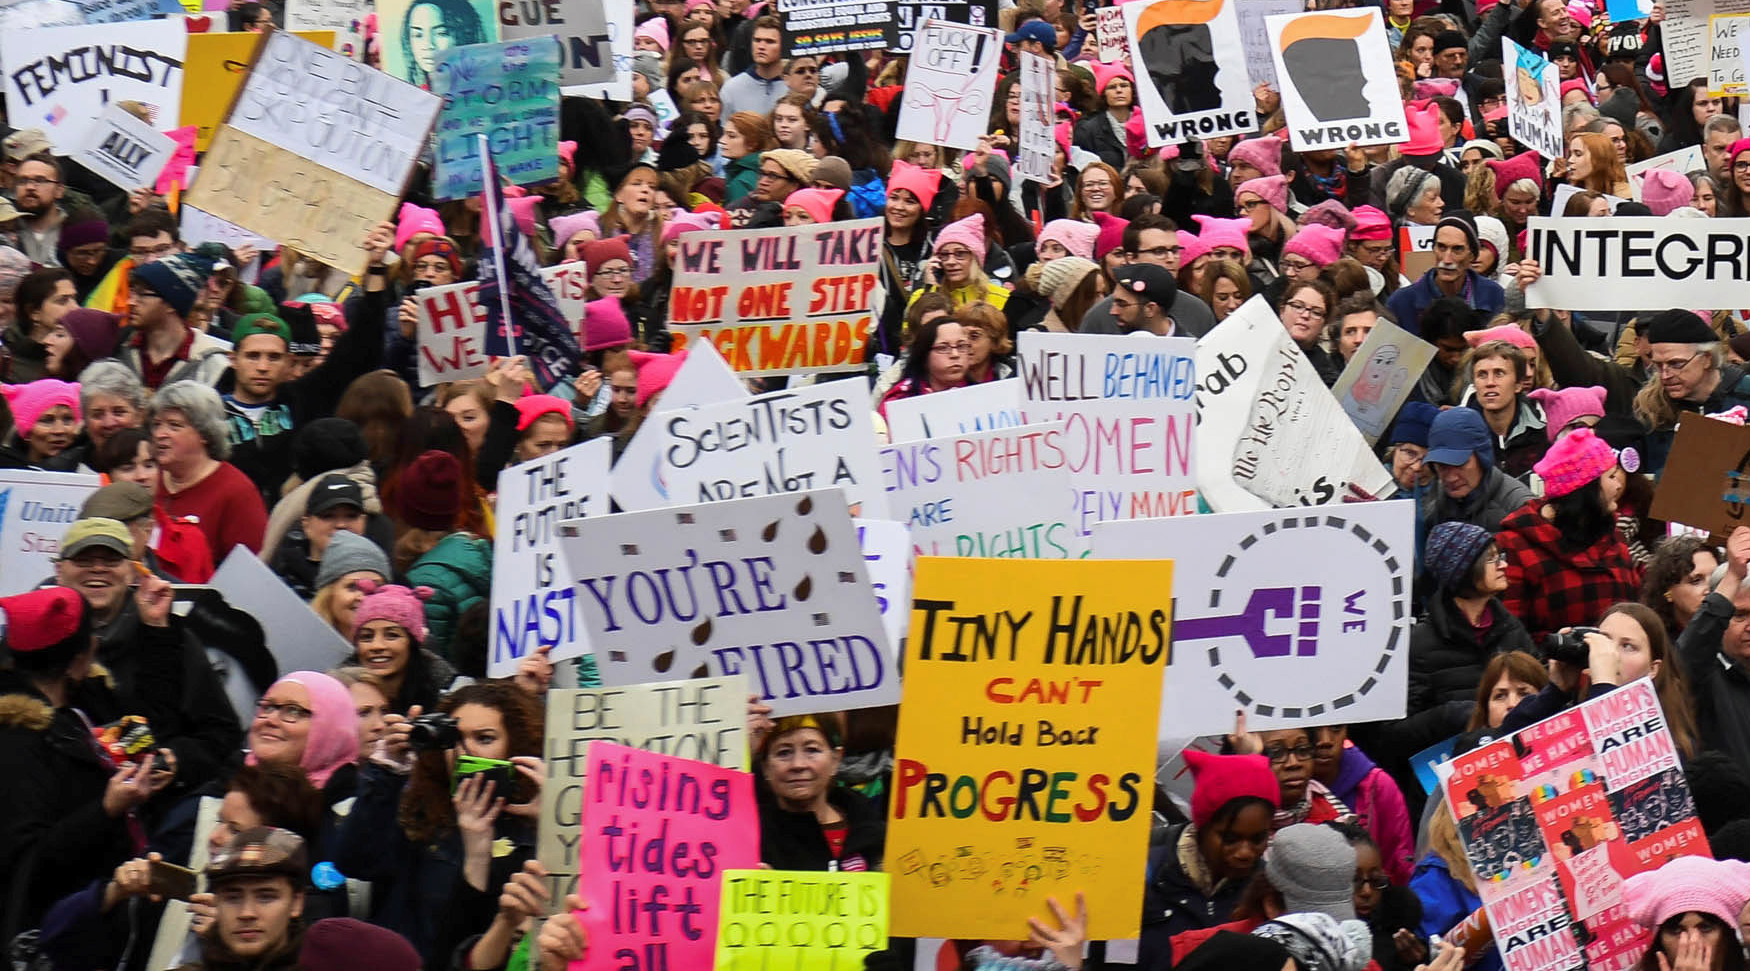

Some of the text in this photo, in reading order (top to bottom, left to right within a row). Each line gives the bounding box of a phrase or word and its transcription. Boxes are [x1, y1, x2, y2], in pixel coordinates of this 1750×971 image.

[13, 44, 184, 105] FEMINIST
[100, 131, 151, 169] ALLY
[1155, 112, 1250, 141] WRONG
[1301, 122, 1399, 144] WRONG
[684, 228, 878, 273] WE WILL TAKE
[672, 275, 875, 323] NOT ONE STEP
[1021, 351, 1194, 400] WELL BEHAVED
[669, 399, 851, 467] SCIENTISTS
[957, 428, 1065, 481] RIGHTS
[526, 456, 569, 496] THE
[582, 550, 787, 632] YOU'RE
[914, 595, 1168, 666] TINY HANDS
[574, 685, 720, 729] BE THE
[987, 678, 1103, 703] CAN'T
[962, 717, 1100, 748] Hold Back
[598, 758, 729, 819] rising
[896, 760, 1139, 823] PROGRESS
[603, 823, 716, 878] tides
[612, 883, 702, 941] lift
